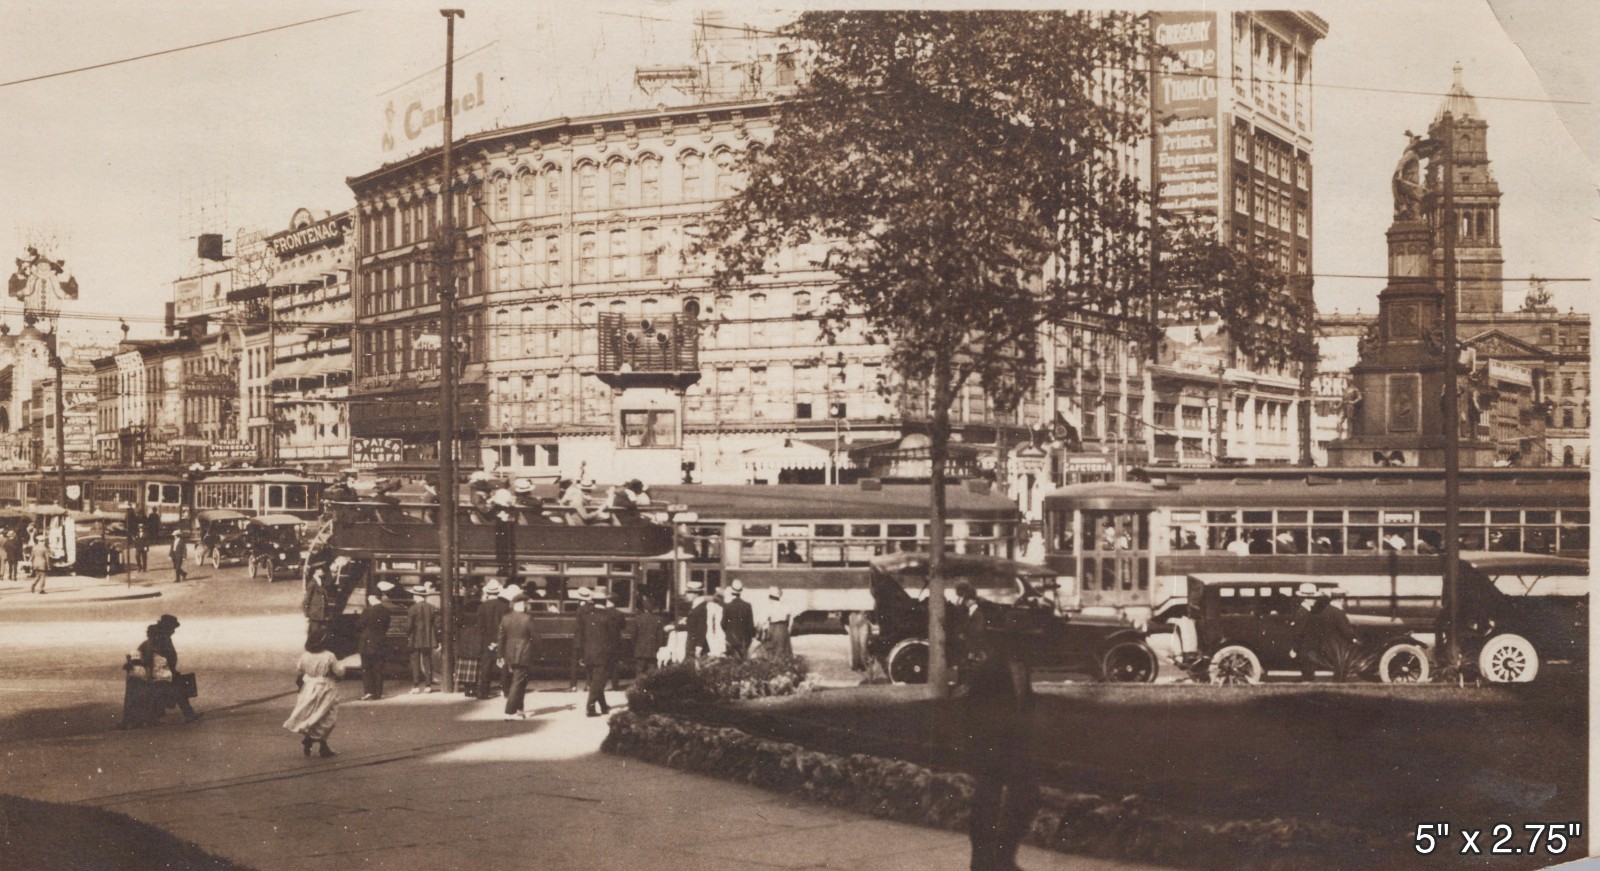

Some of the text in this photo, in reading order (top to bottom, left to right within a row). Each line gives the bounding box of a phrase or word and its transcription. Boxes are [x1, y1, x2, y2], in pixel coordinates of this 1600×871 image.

[404, 71, 485, 140] Camel
[273, 220, 338, 254] FRONTENAC
[355, 438, 401, 452] SPATER
